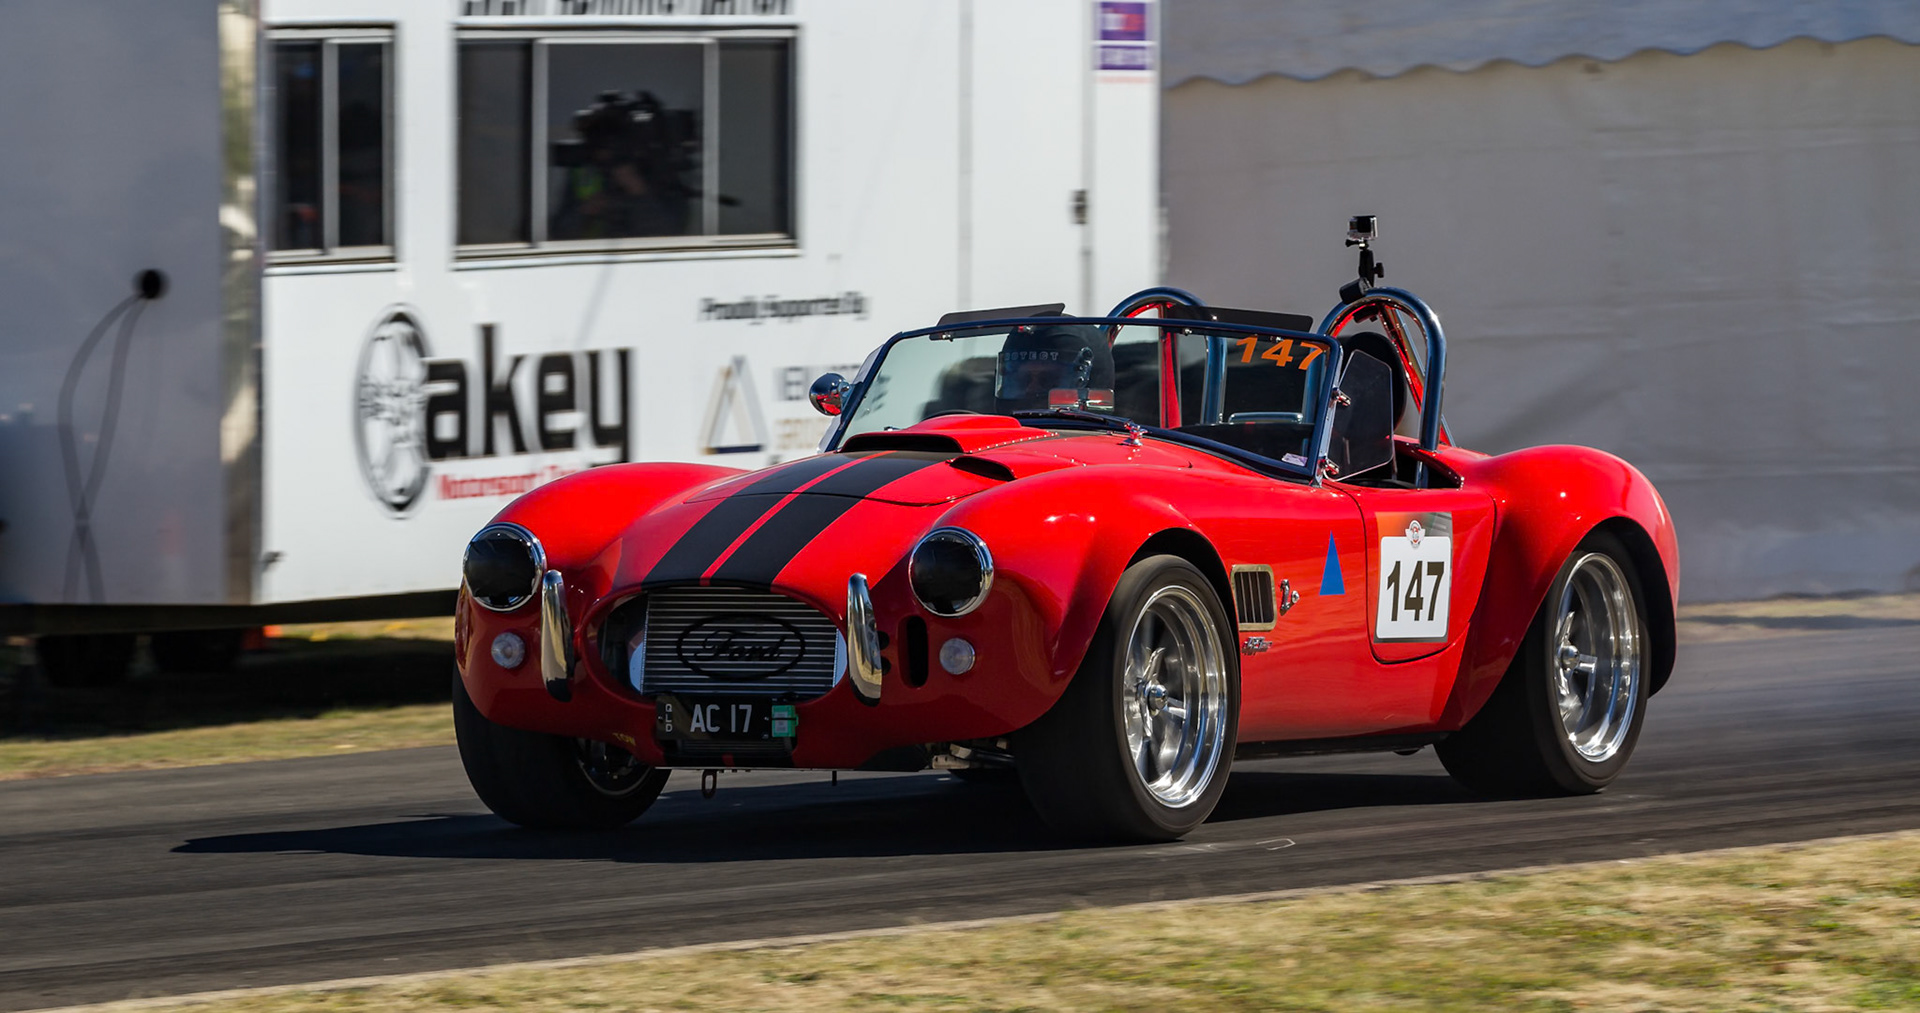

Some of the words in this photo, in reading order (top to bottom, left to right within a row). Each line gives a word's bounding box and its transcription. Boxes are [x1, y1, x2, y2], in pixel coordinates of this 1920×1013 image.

[1236, 335, 1329, 370] 147
[1386, 560, 1445, 622] 147
[694, 629, 788, 662] Ford
[690, 704, 721, 733] AC
[730, 704, 753, 733] 17
